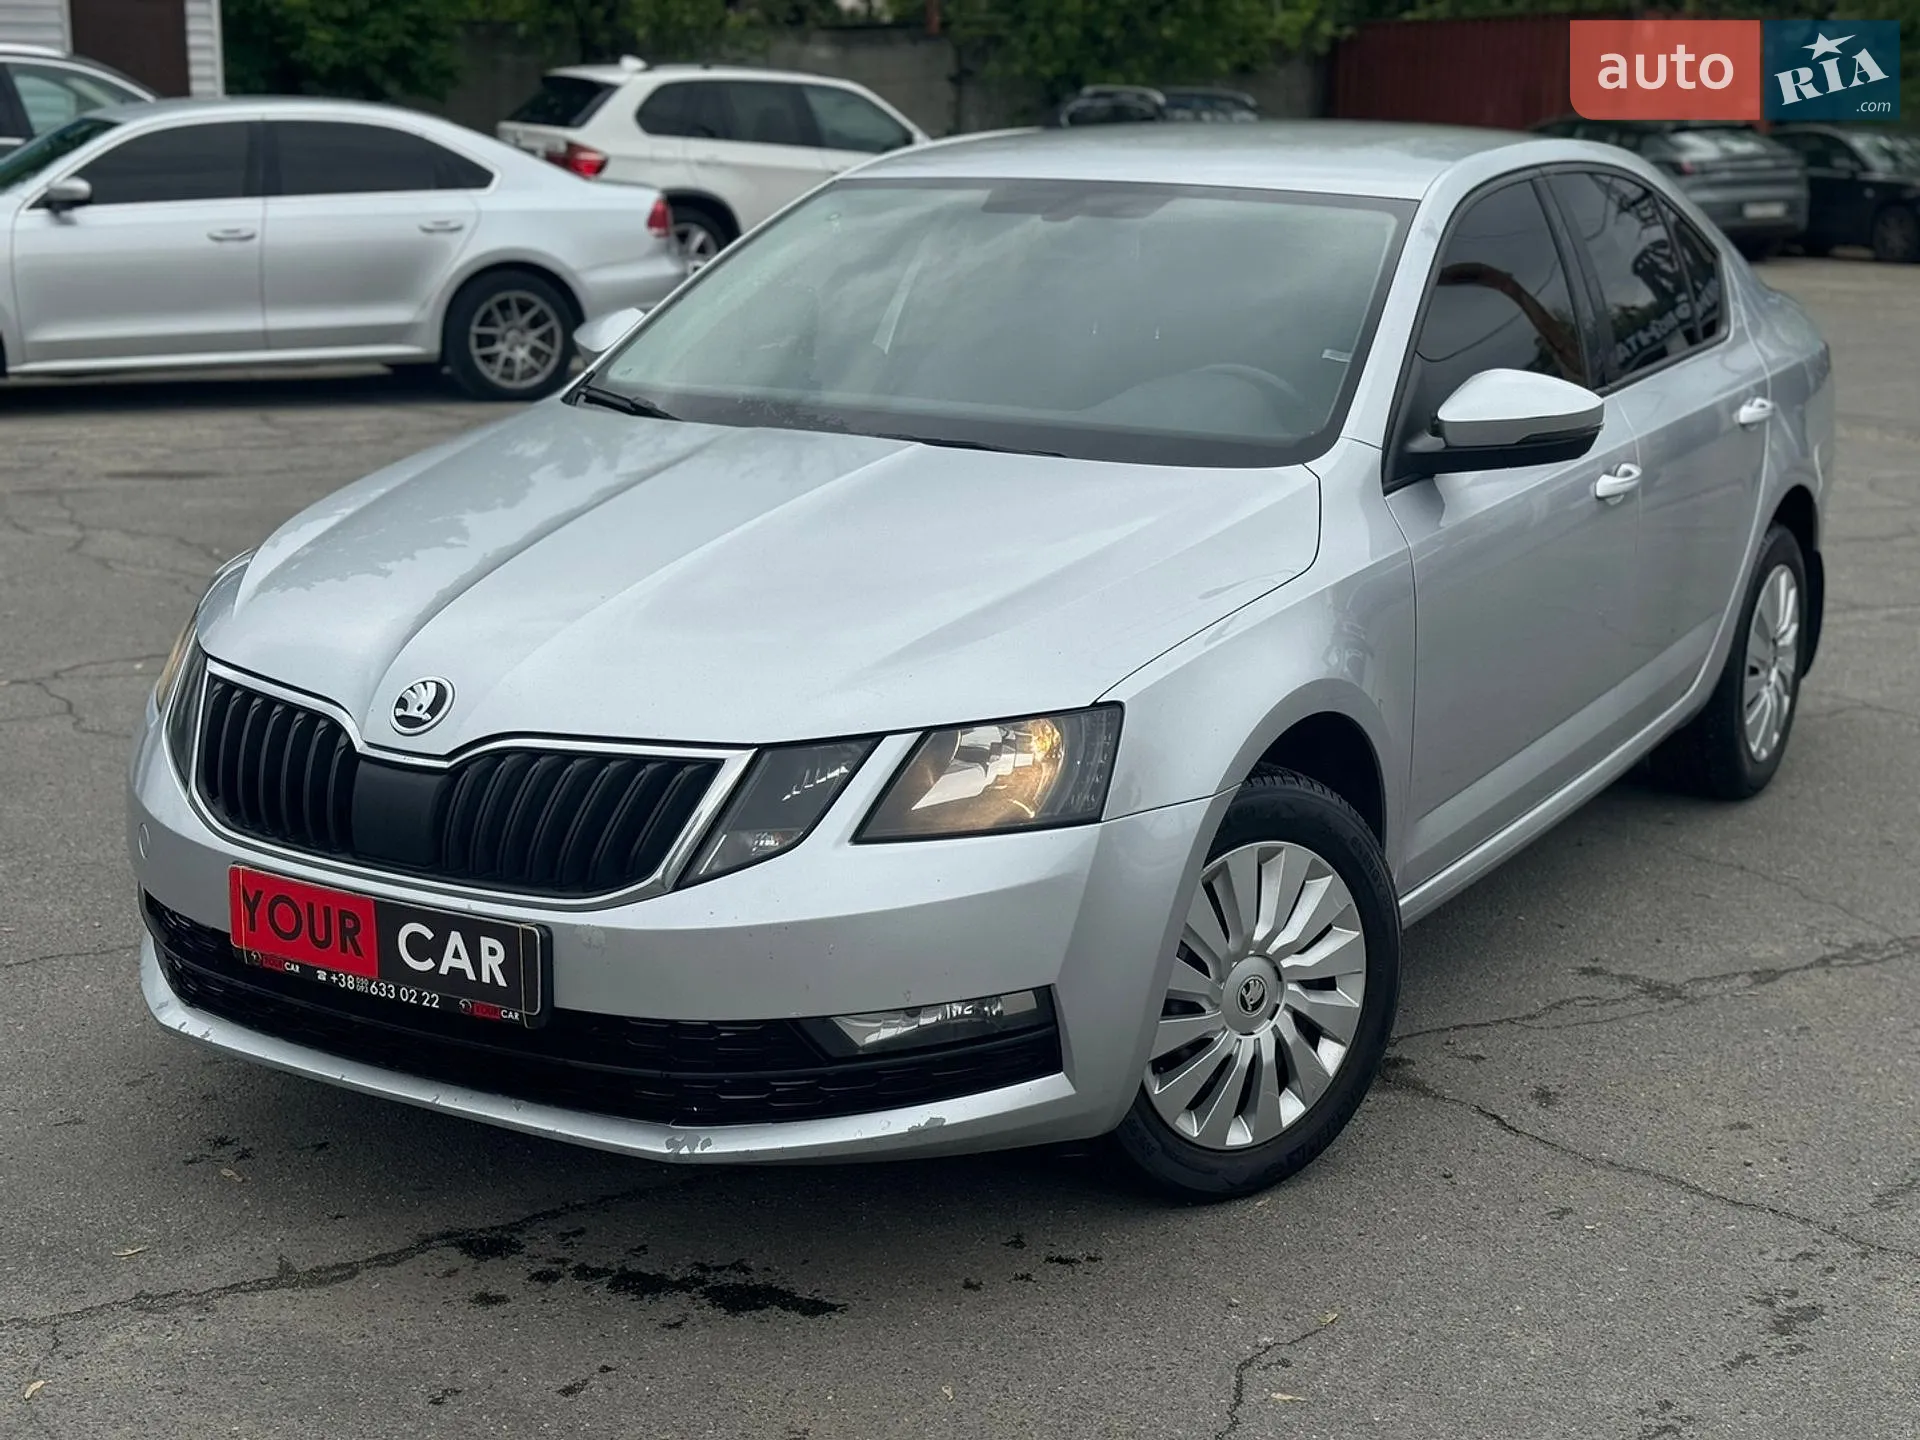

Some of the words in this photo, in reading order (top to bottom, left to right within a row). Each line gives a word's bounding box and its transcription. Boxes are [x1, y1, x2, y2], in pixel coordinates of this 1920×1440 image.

[242, 888, 364, 958] YOUR
[397, 922, 508, 988] CAR
[330, 973, 355, 990] +38
[369, 981, 396, 999] 633
[400, 987, 418, 1004] 02
[421, 991, 440, 1008] 22
[501, 1009, 520, 1021] CAR
